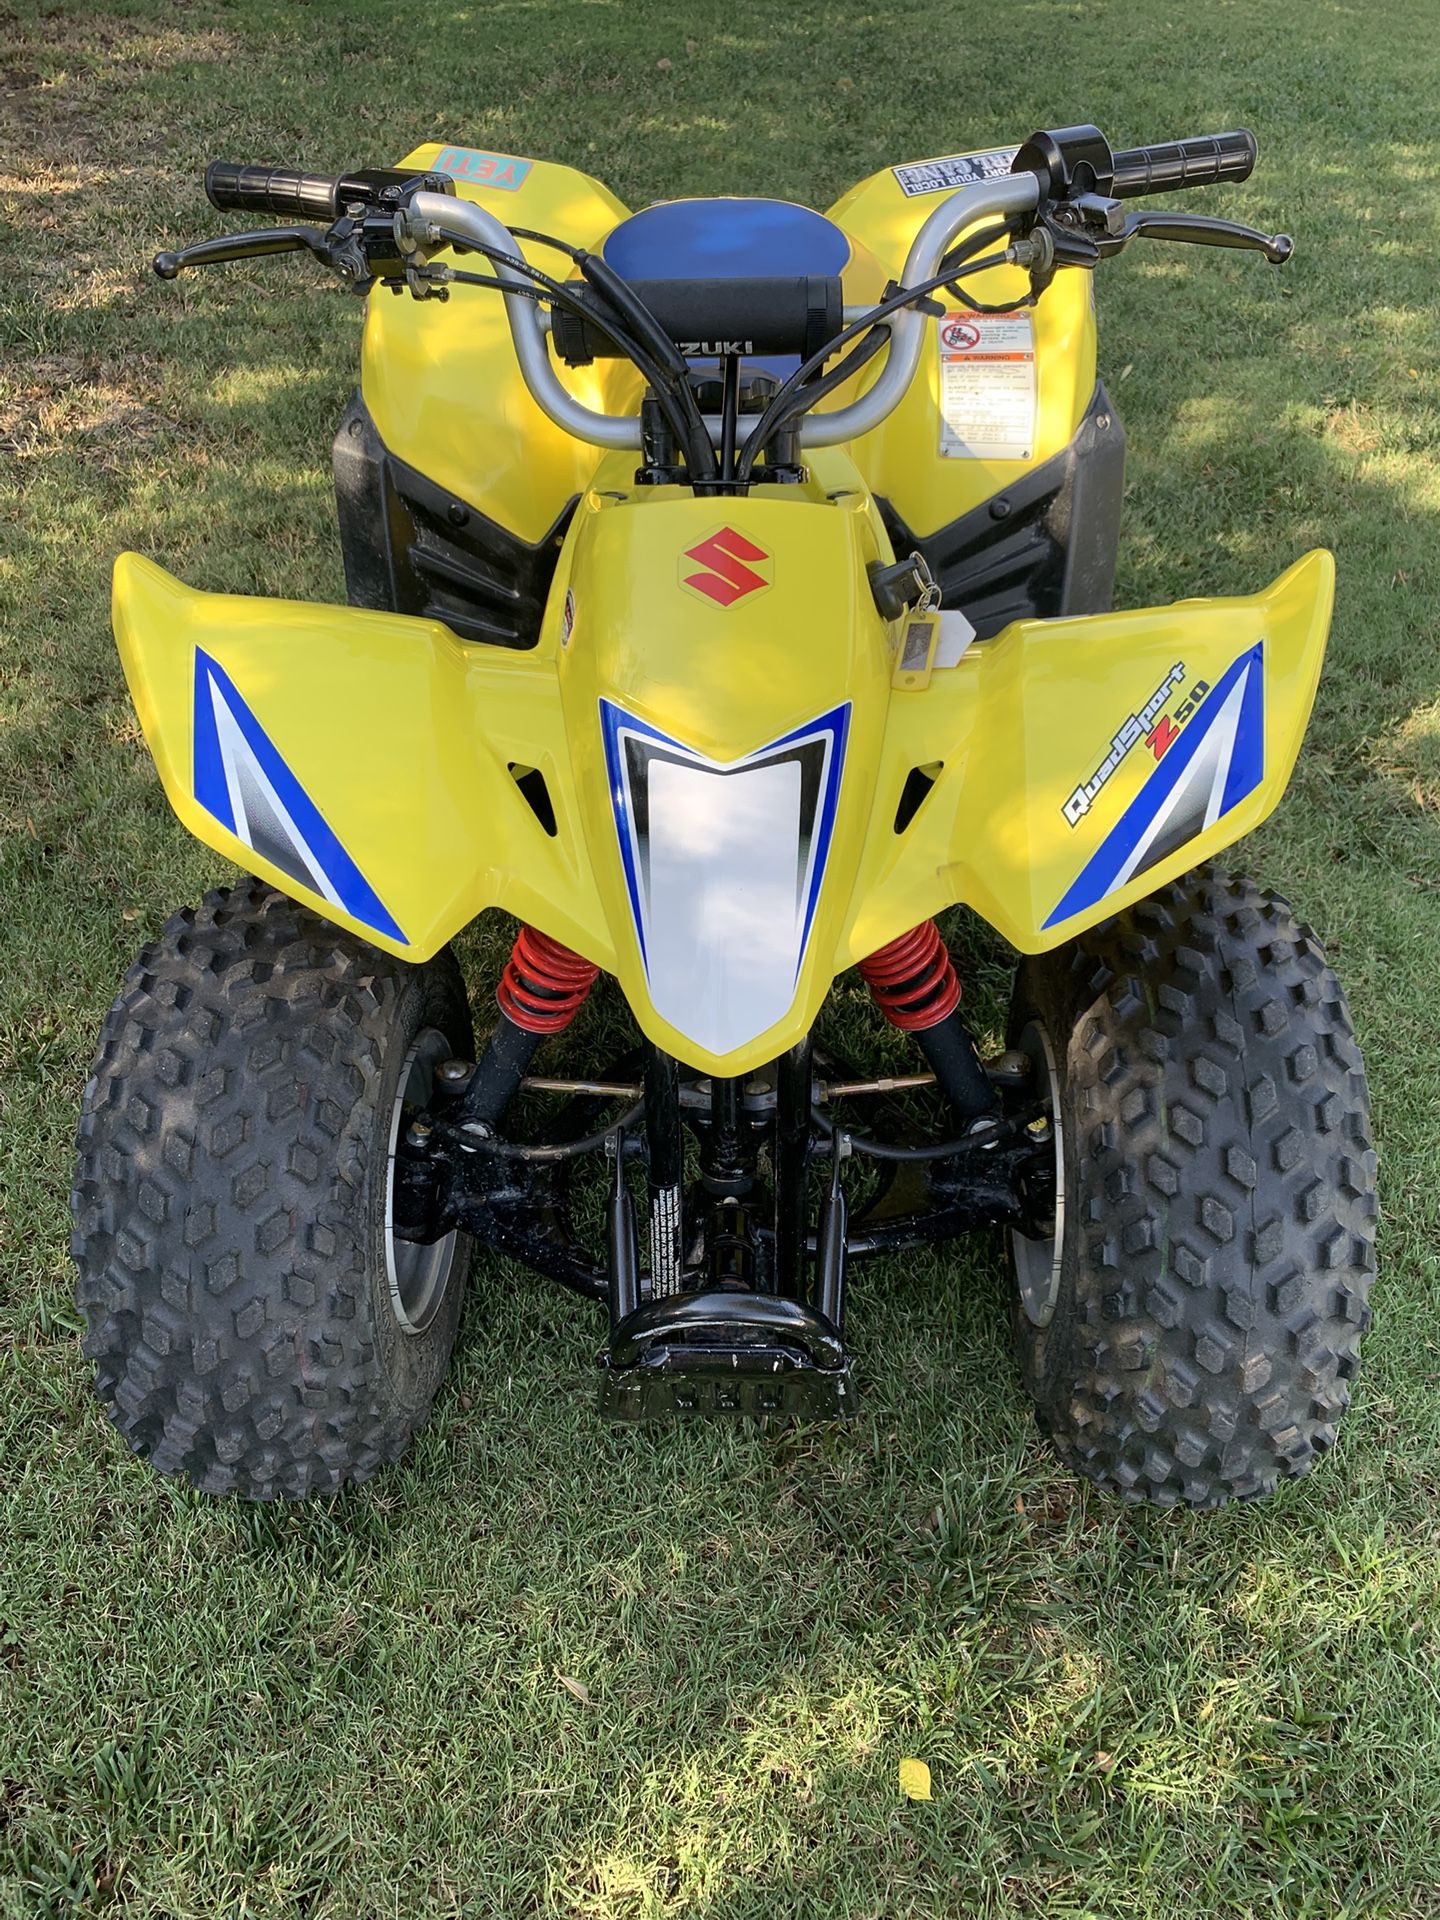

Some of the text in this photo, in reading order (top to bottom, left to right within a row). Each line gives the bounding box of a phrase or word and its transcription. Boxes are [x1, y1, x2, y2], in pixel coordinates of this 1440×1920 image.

[442, 153, 515, 184] YETI
[947, 173, 981, 184] YOUR
[907, 178, 946, 192] LOCAL
[1061, 661, 1186, 828] QuadSport
